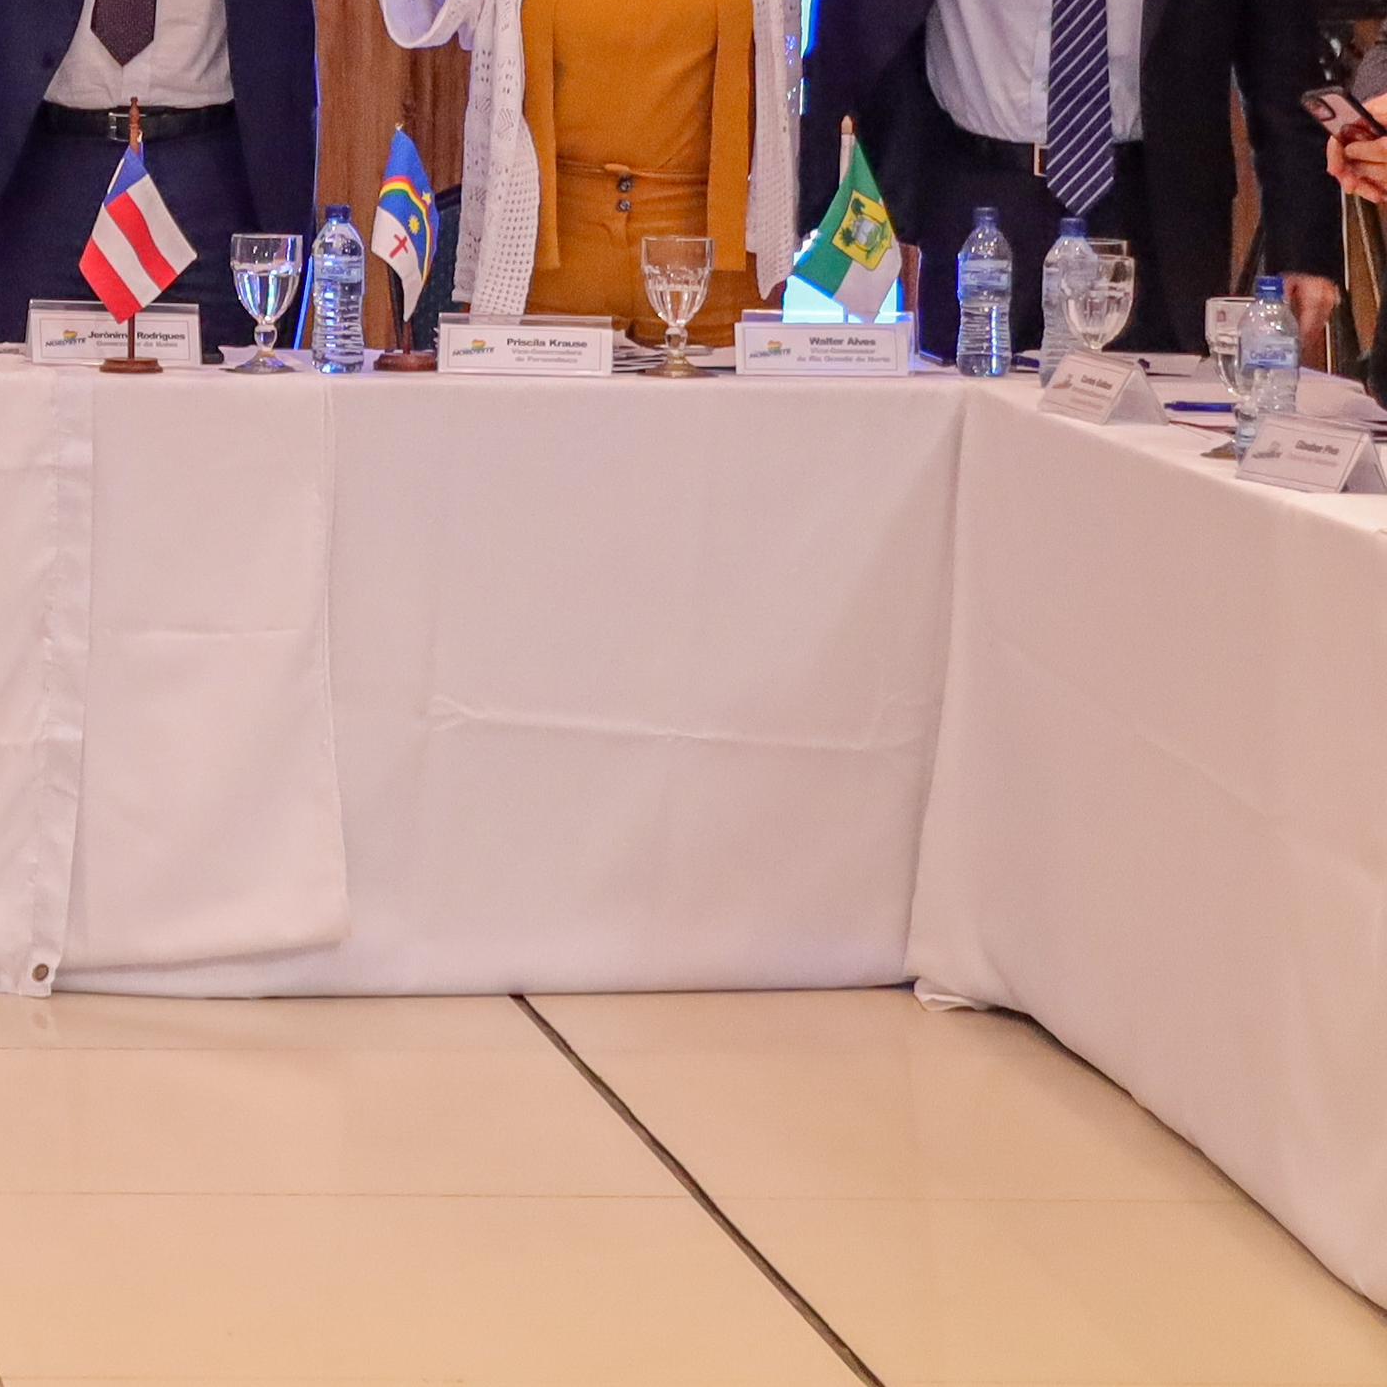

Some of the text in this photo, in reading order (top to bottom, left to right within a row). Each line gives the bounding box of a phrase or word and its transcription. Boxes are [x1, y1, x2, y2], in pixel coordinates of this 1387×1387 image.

[136, 331, 186, 341] Rodrigues
[506, 338, 588, 348] Priscila Krause
[809, 337, 876, 346] Walter Alves
